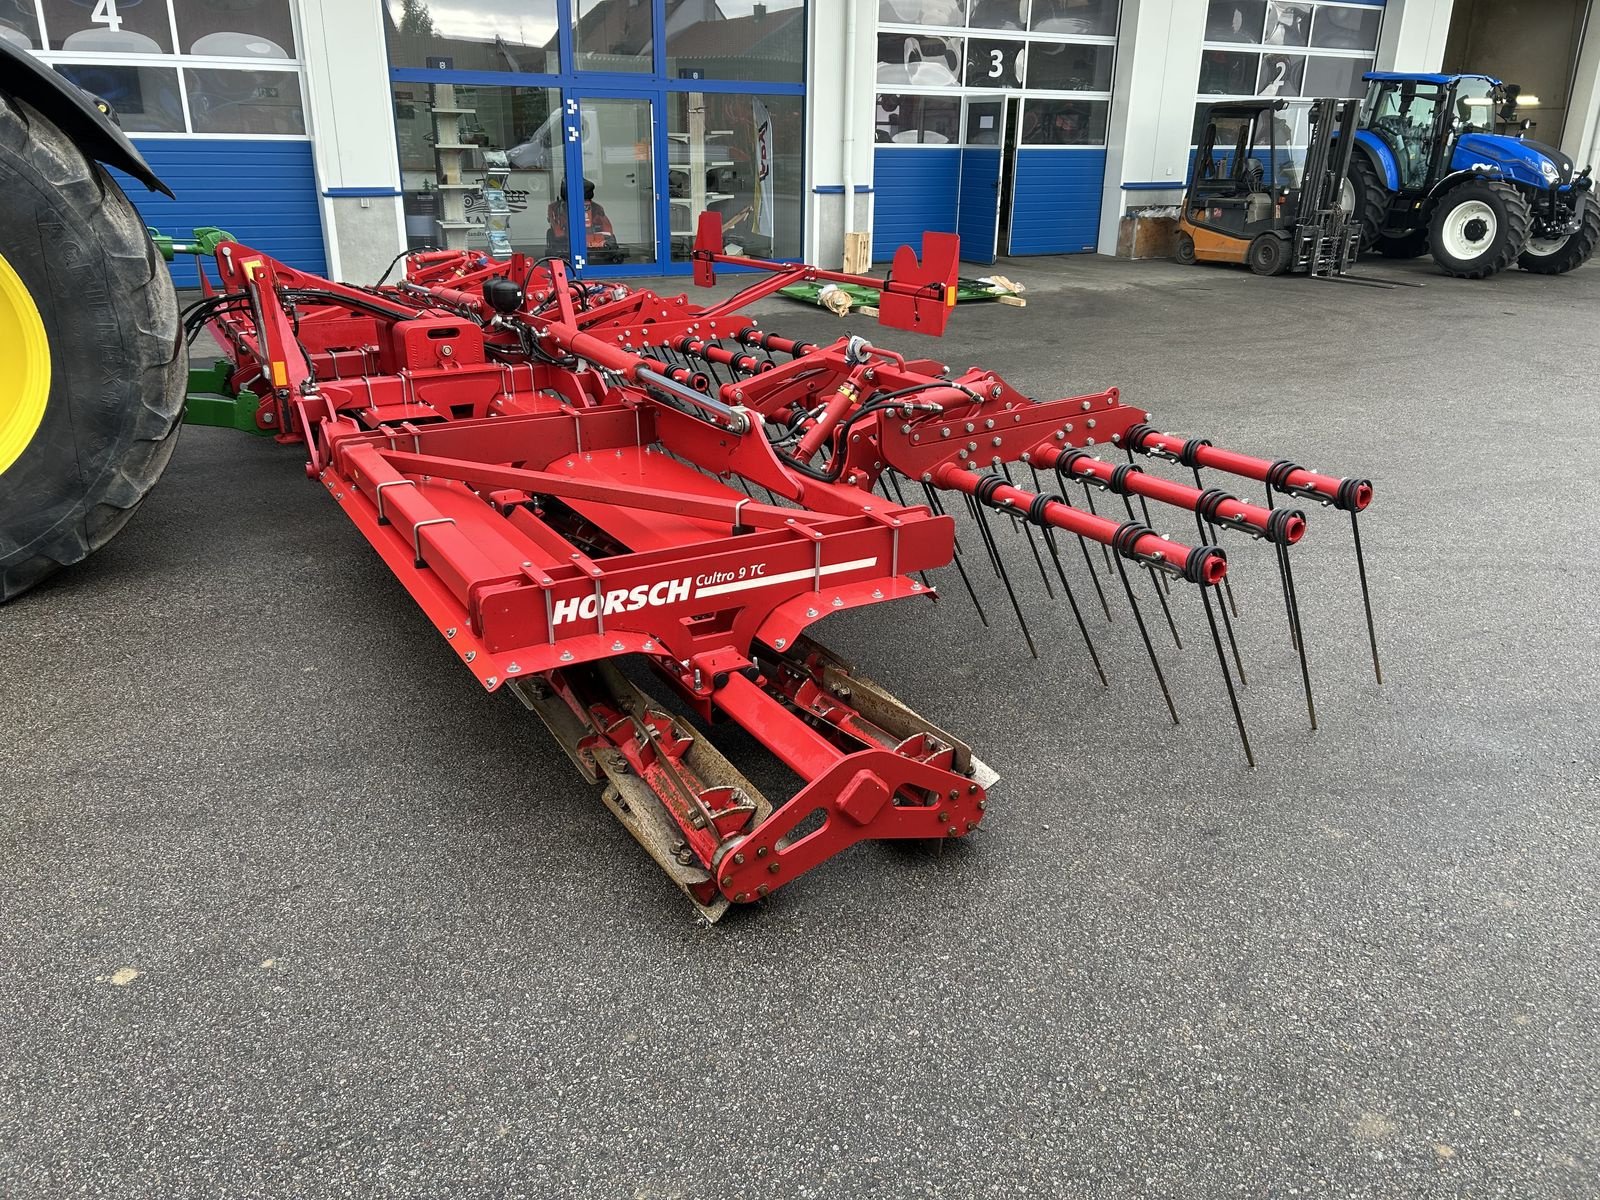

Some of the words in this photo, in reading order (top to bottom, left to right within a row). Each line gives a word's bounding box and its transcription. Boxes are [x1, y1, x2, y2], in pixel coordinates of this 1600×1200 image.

[91, 0, 123, 32] 4
[988, 49, 1003, 78] 3
[1272, 61, 1287, 87] 2
[552, 577, 692, 625] HORSCH
[696, 571, 735, 586] Cultro
[738, 566, 747, 579] 9
[750, 563, 766, 577] TC
